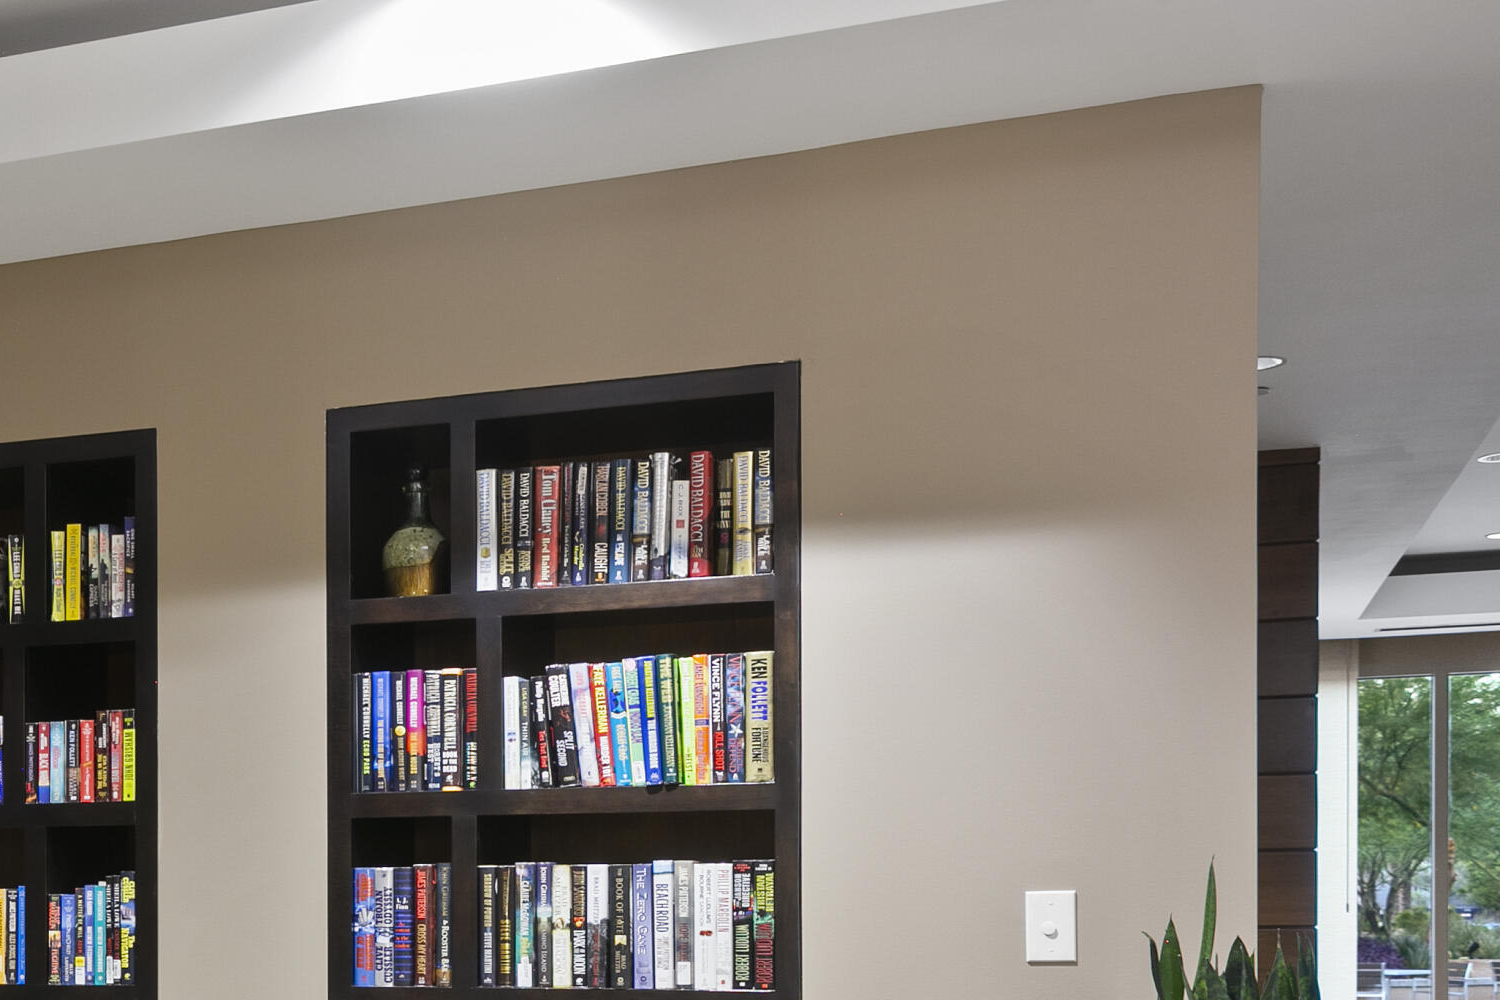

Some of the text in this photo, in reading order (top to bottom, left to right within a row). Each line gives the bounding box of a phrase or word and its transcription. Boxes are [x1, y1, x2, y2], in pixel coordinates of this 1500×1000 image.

[501, 474, 512, 545] DAVID BALDACCI
[519, 473, 530, 537] DAVID BALDACCI
[637, 461, 649, 534] DAVID BALDACCI
[691, 454, 704, 543] DAVID BALDACCI
[758, 449, 771, 524] DAVID BALDACCI
[538, 472, 557, 581] Tom Clancy Red Rabbit
[594, 466, 608, 574] HARLAN COBEN CAUGHT
[614, 467, 625, 566] DAVID BALDACCI ESCAPE
[13, 551, 21, 615] LEE CHILD MAKE ME
[505, 548, 514, 575] SPLIT
[427, 674, 440, 737] PATRICIA CORNWELL
[443, 679, 457, 712] PATRICIA
[548, 675, 561, 708] COULTER
[660, 658, 672, 703] THE WEB
[752, 658, 768, 721] KEN FOLLETT
[443, 712, 457, 751] CORNWELL
[564, 730, 574, 751] SPLIT
[592, 668, 611, 778] FAYE KELLERMAN MURDER 101
[711, 658, 724, 771] VINCE FLYNN KILL SHOT
[556, 739, 567, 767] SECOND
[752, 727, 762, 763] FORTUNE
[384, 887, 392, 925] ODYSSEY
[616, 877, 624, 935] BOOK OF FATE
[636, 868, 646, 955] THE ZERO GAME
[656, 883, 669, 933] BEACH ROAD
[756, 875, 765, 910] TRISTAN
[766, 872, 775, 912] BETRAYAL
[120, 928, 129, 968] NAVIGATOR
[417, 870, 427, 975] JAMES PATTERSON CROSS MY HEART
[441, 926, 450, 957] ROOSTER
[384, 946, 392, 983] CUSSLER
[573, 930, 586, 975] DARK MOON
[735, 924, 750, 981] ROBERT LUDLUM
[756, 923, 773, 983] ROBERT LUDLUM
